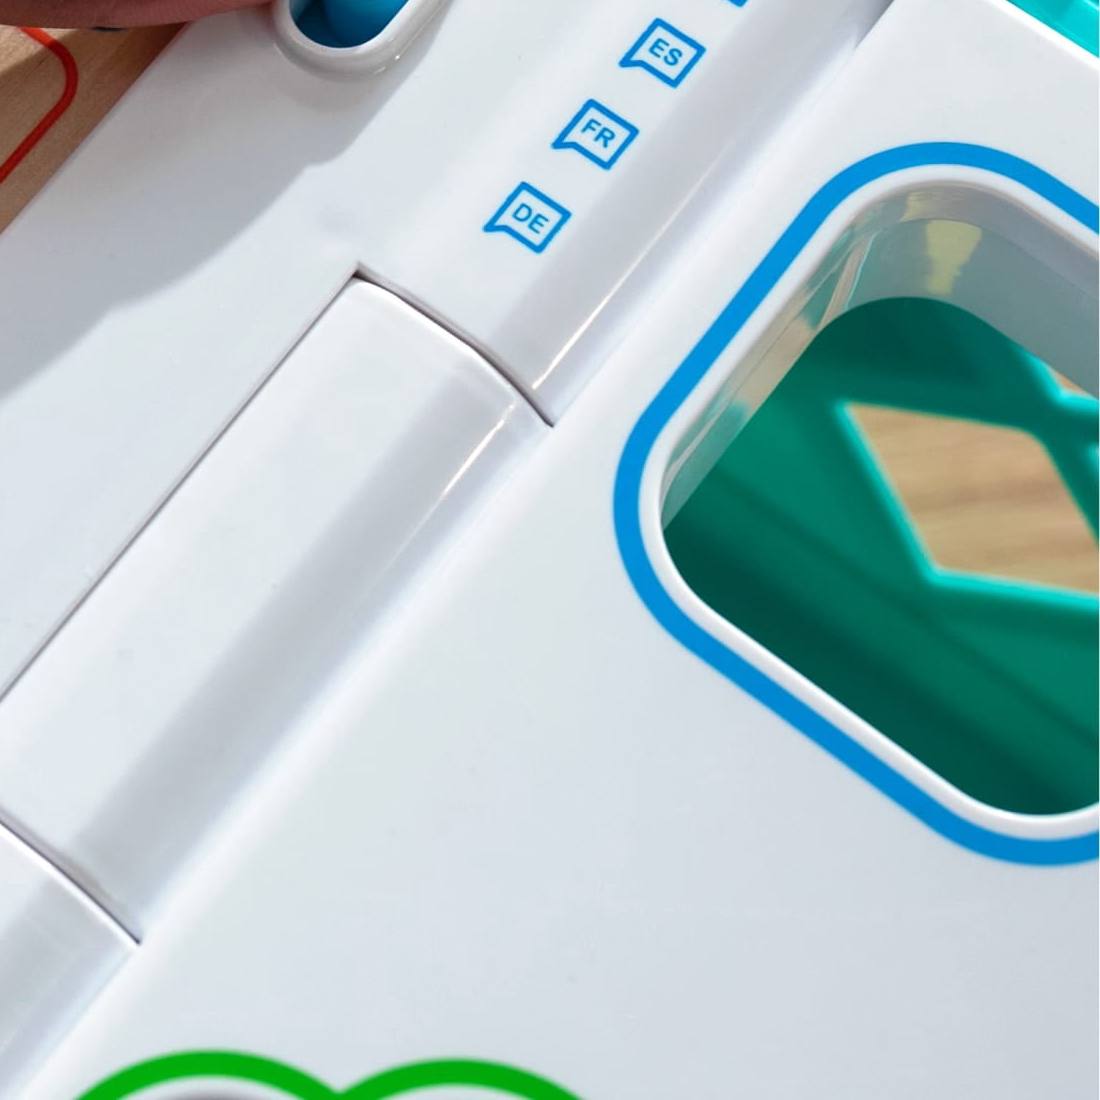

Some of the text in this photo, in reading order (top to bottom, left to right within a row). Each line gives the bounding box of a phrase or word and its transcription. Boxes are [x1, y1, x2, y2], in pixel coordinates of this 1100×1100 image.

[649, 38, 683, 67] ES
[581, 118, 616, 149] FR
[512, 203, 549, 234] DE
